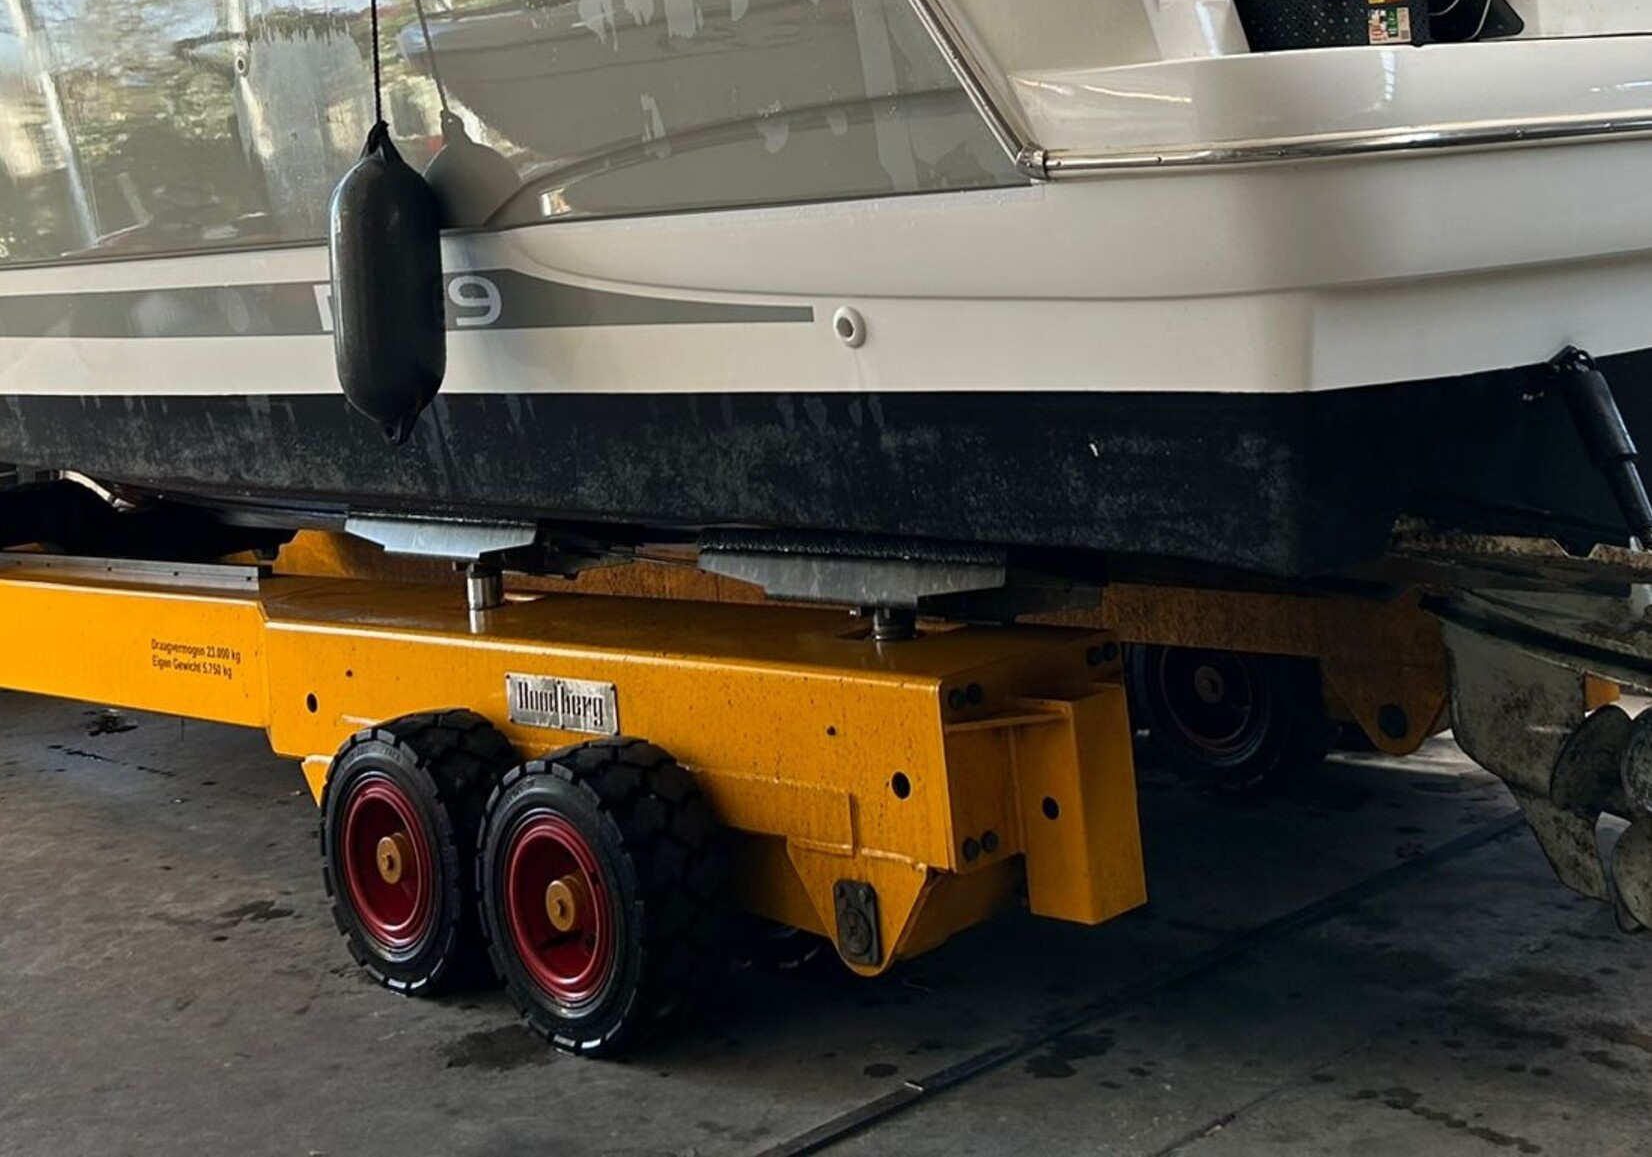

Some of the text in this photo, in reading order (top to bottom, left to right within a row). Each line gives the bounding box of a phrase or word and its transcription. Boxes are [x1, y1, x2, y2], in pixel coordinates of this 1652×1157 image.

[206, 646, 229, 660] 23.000
[231, 648, 241, 664] kg
[152, 654, 232, 680] Eigen Gewicht 5.750 kg
